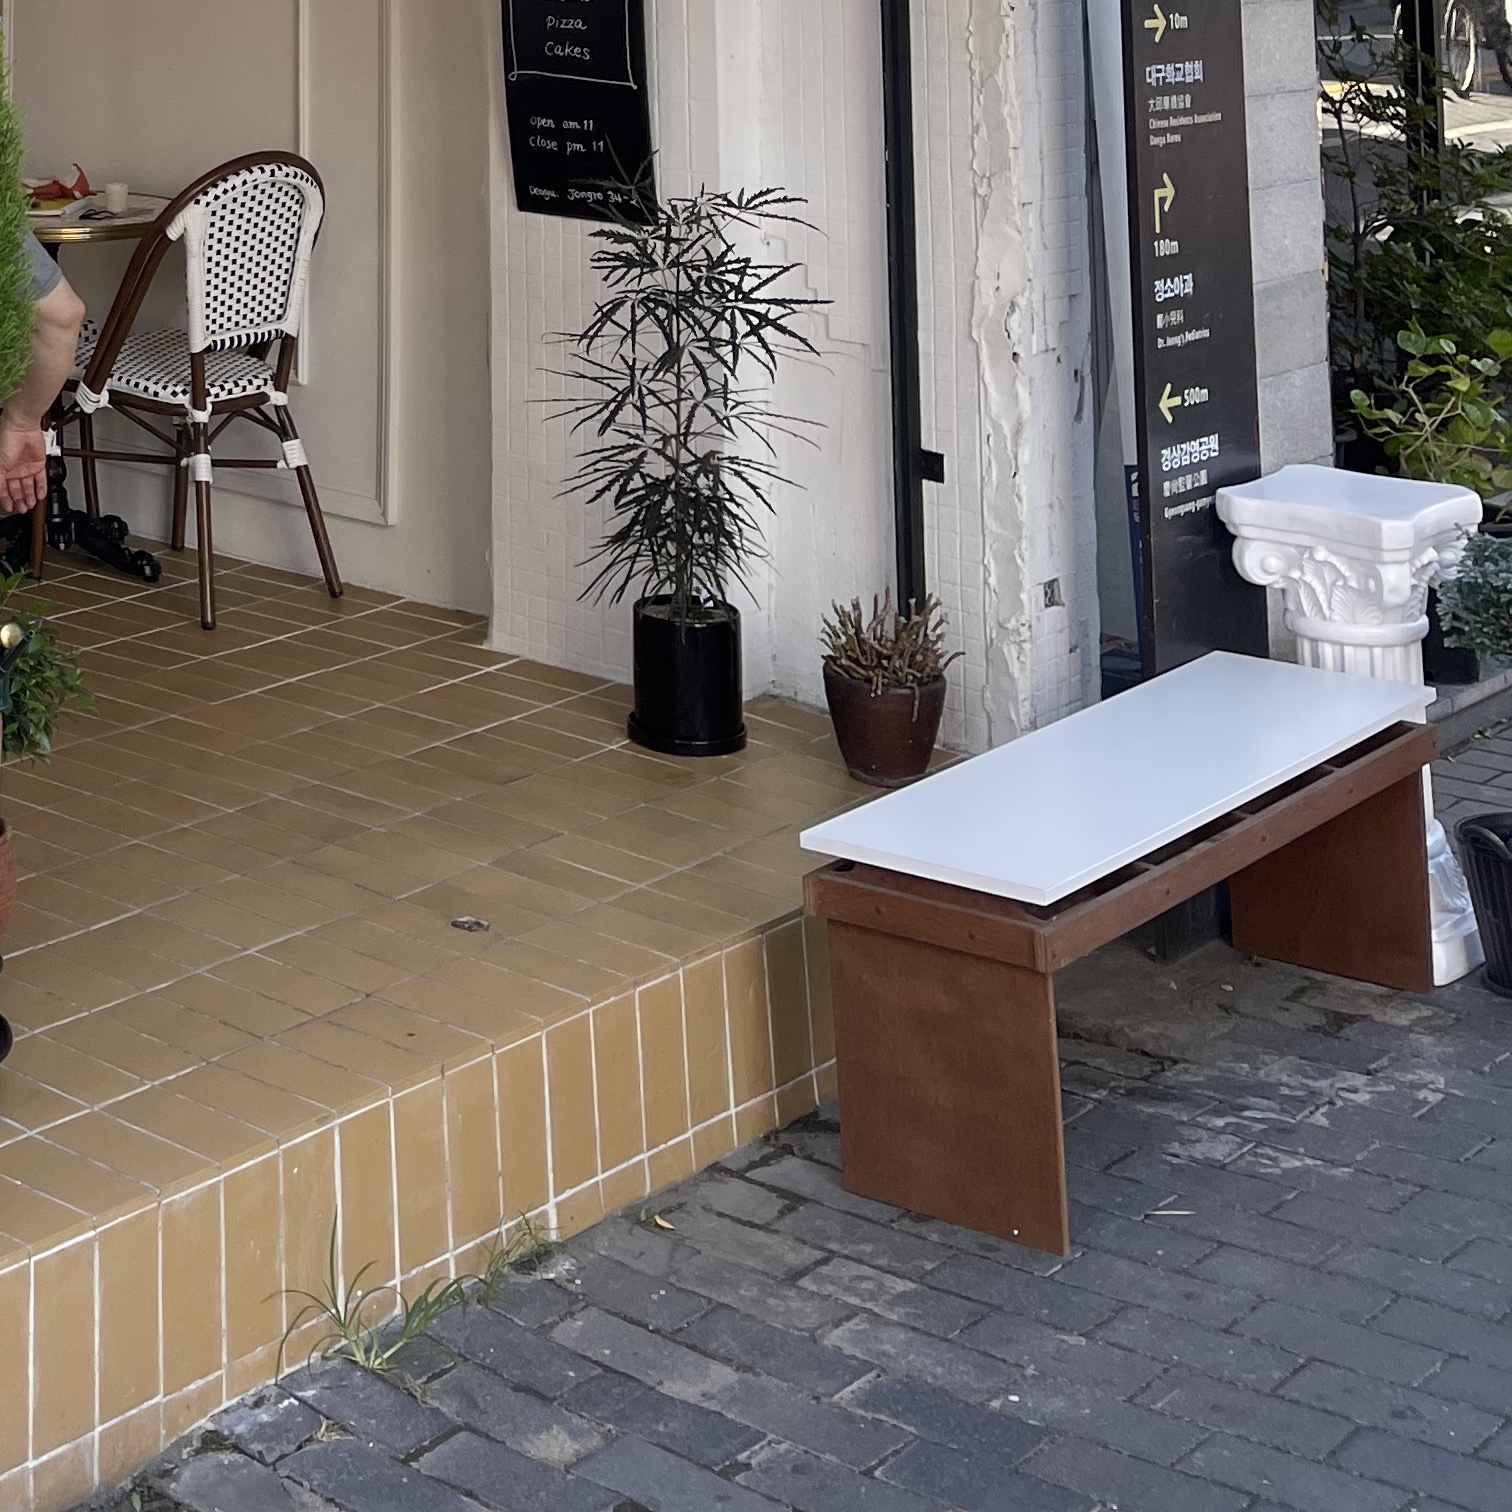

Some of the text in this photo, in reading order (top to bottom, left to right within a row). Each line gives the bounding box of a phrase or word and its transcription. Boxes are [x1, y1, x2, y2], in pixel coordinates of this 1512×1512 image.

[546, 14, 588, 30] Pizza
[1169, 12, 1189, 30] 10m
[544, 40, 591, 60] Cakes
[1145, 59, 1204, 87] 대구화교협회
[567, 188, 604, 202] Jongro
[1153, 238, 1179, 257] 180m
[1154, 272, 1194, 303] 정소아과
[1183, 386, 1209, 407] 500m
[1160, 433, 1219, 472] 경상감영공원
